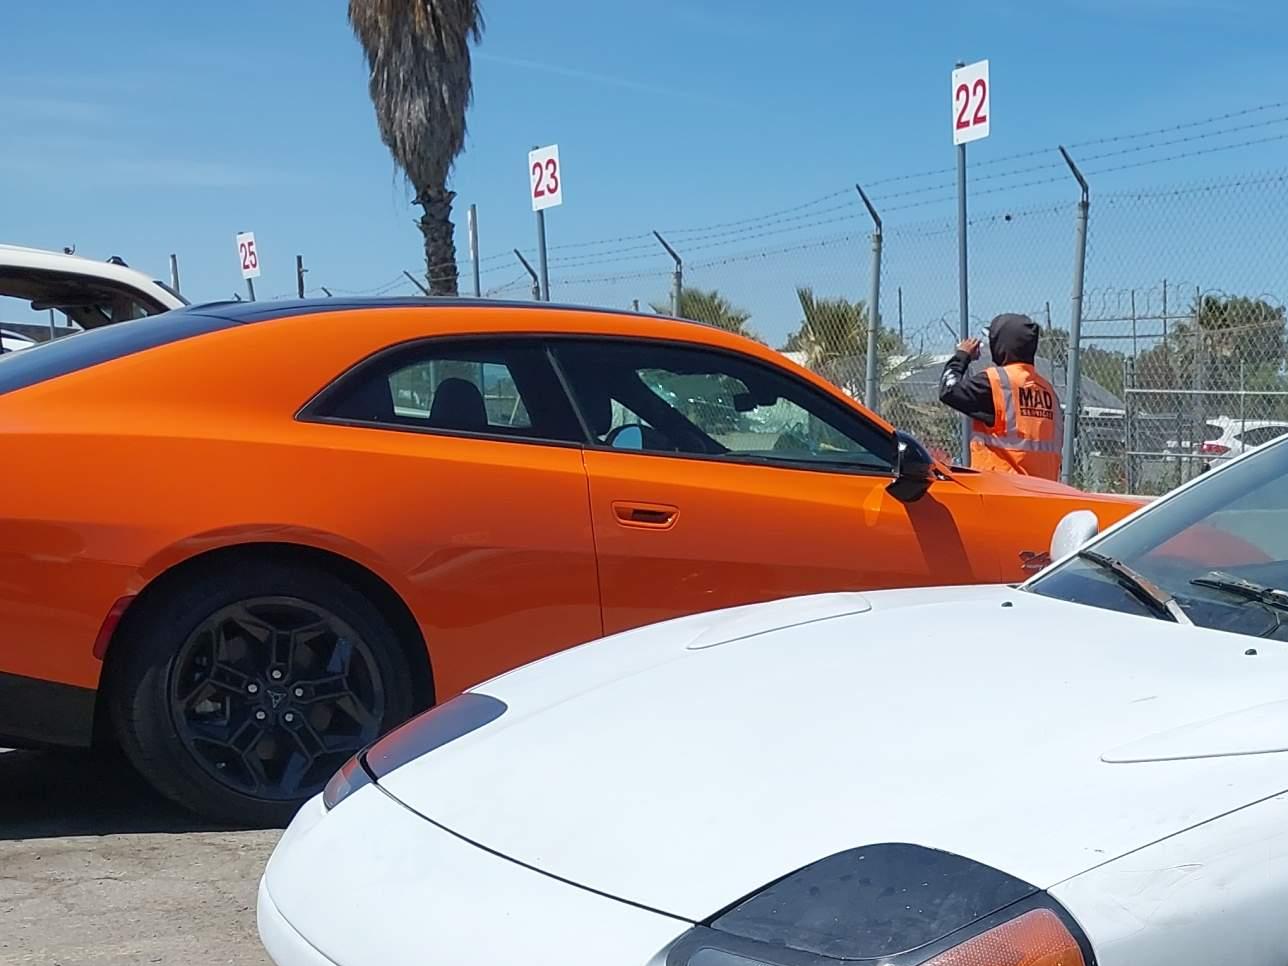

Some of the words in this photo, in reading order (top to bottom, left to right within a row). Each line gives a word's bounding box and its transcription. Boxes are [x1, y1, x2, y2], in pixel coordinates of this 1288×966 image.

[956, 78, 987, 130] 22
[532, 158, 559, 198] 23
[239, 241, 257, 270] 25
[1018, 386, 1053, 410] MAD
